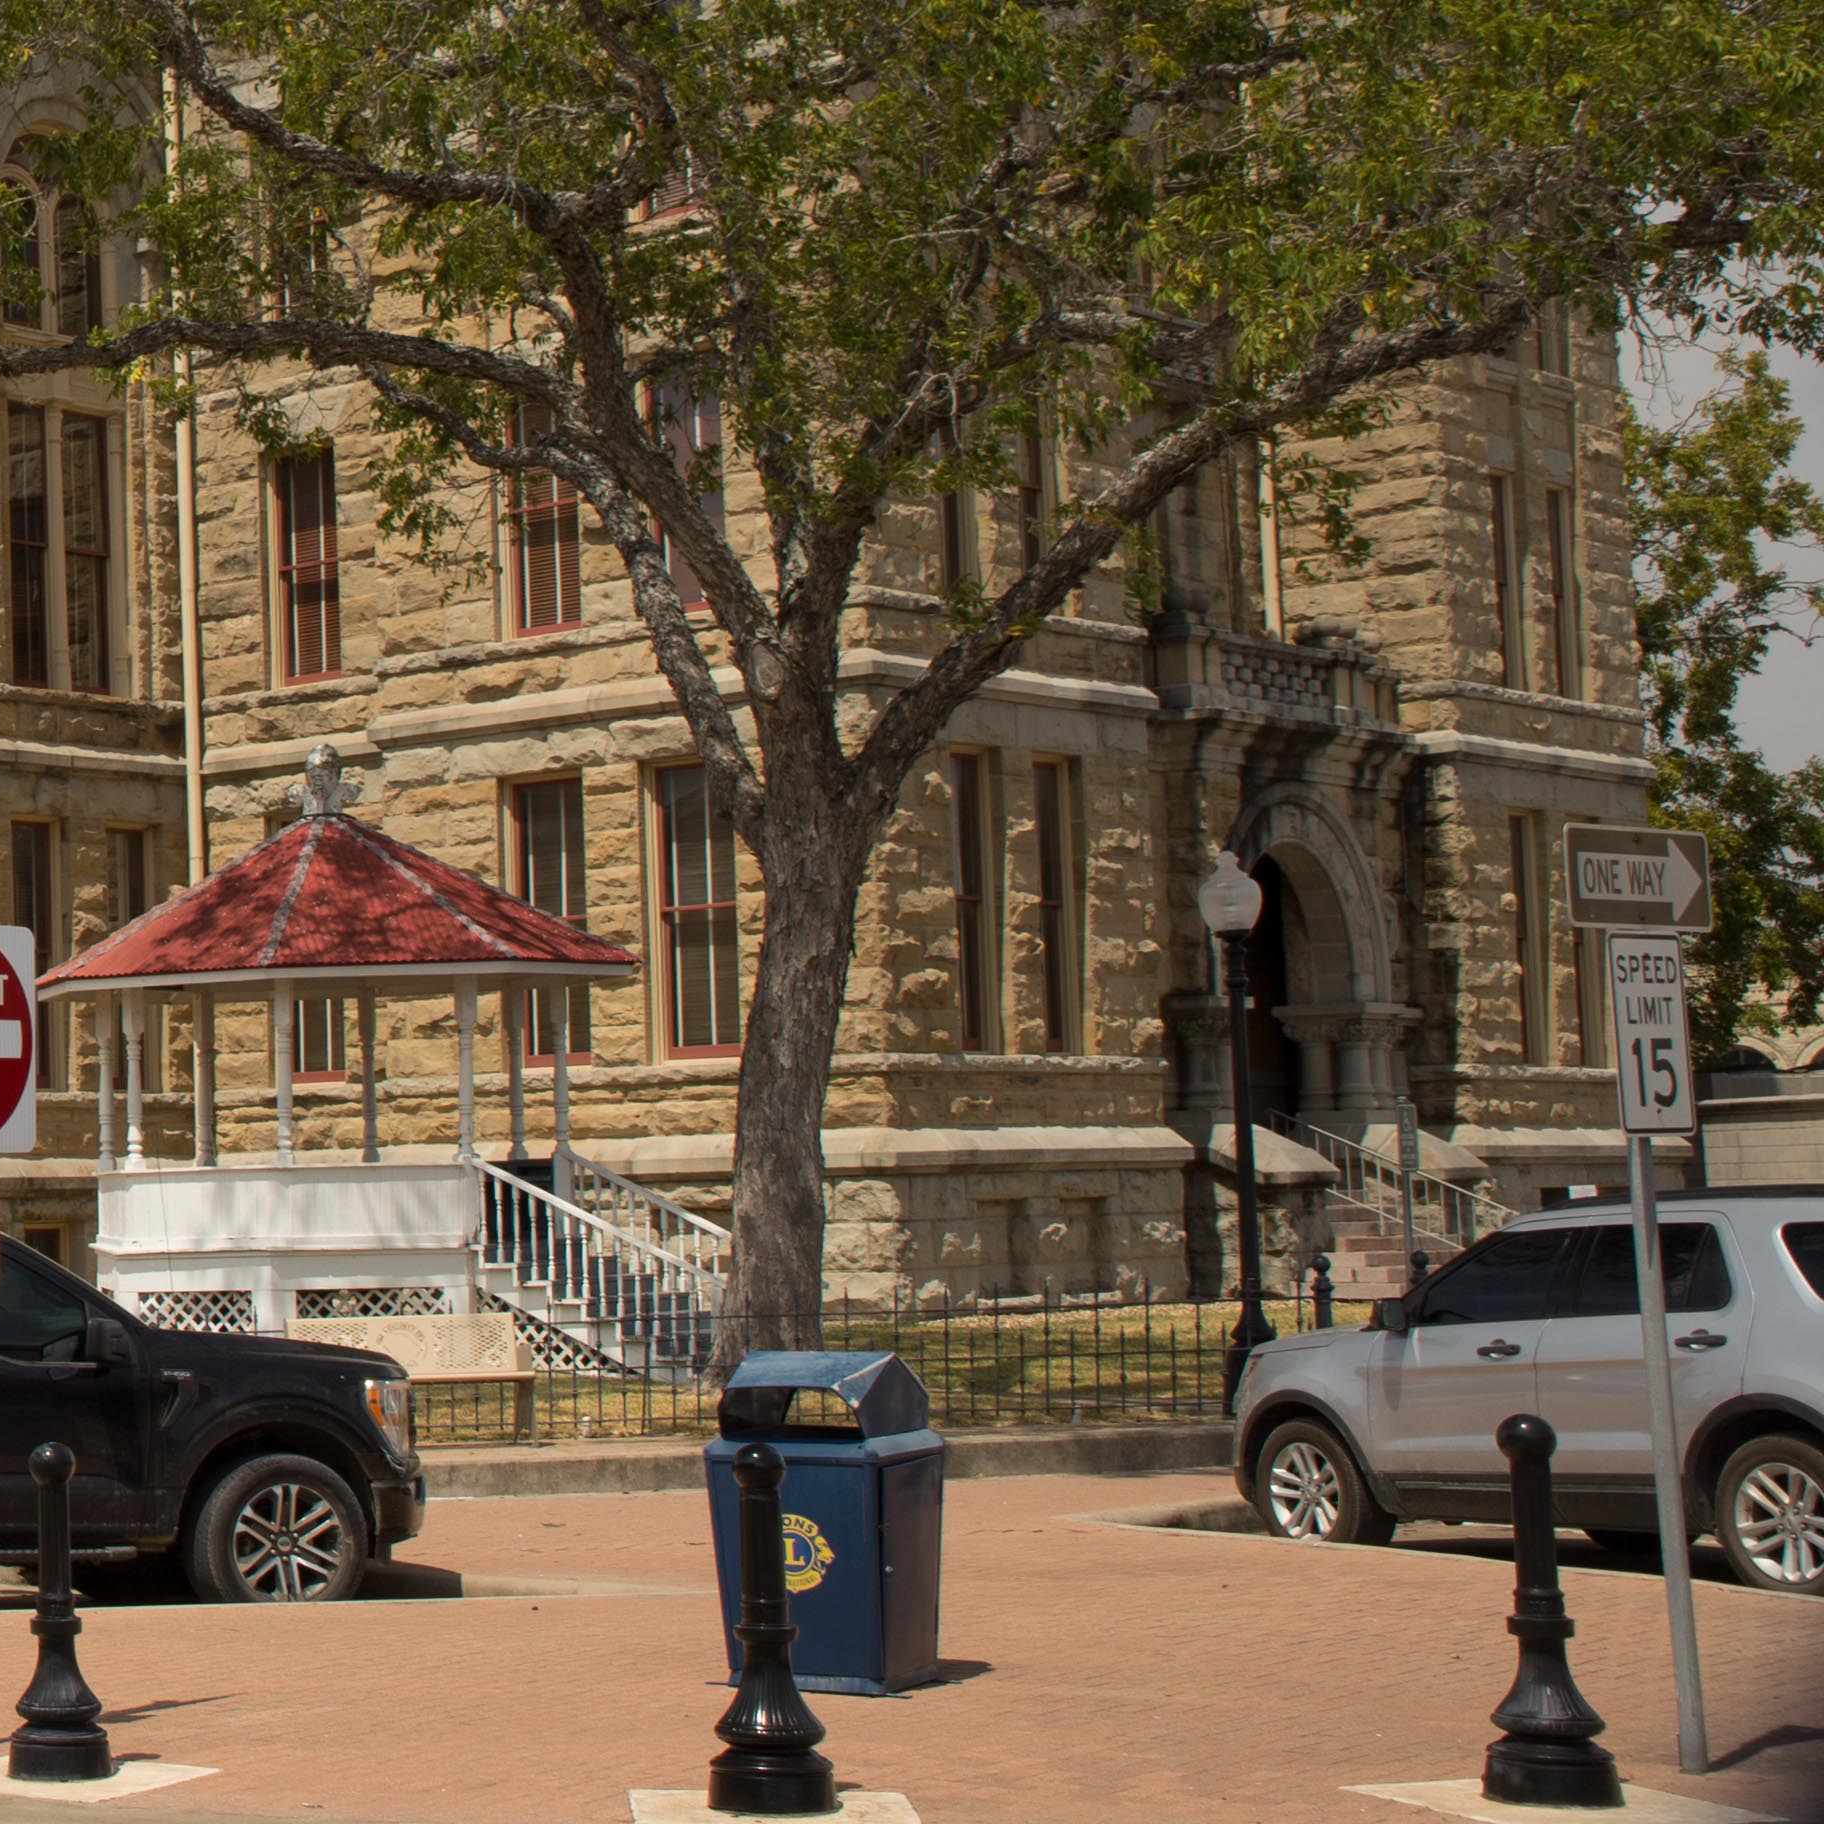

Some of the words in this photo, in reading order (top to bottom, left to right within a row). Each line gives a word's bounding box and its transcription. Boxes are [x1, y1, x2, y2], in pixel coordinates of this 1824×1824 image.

[1583, 857, 1622, 894] ONE
[1627, 860, 1666, 896] WAY
[1616, 954, 1677, 984] SPEED
[1625, 996, 1673, 1025] LIMIT
[1631, 1037, 1677, 1108] 15
